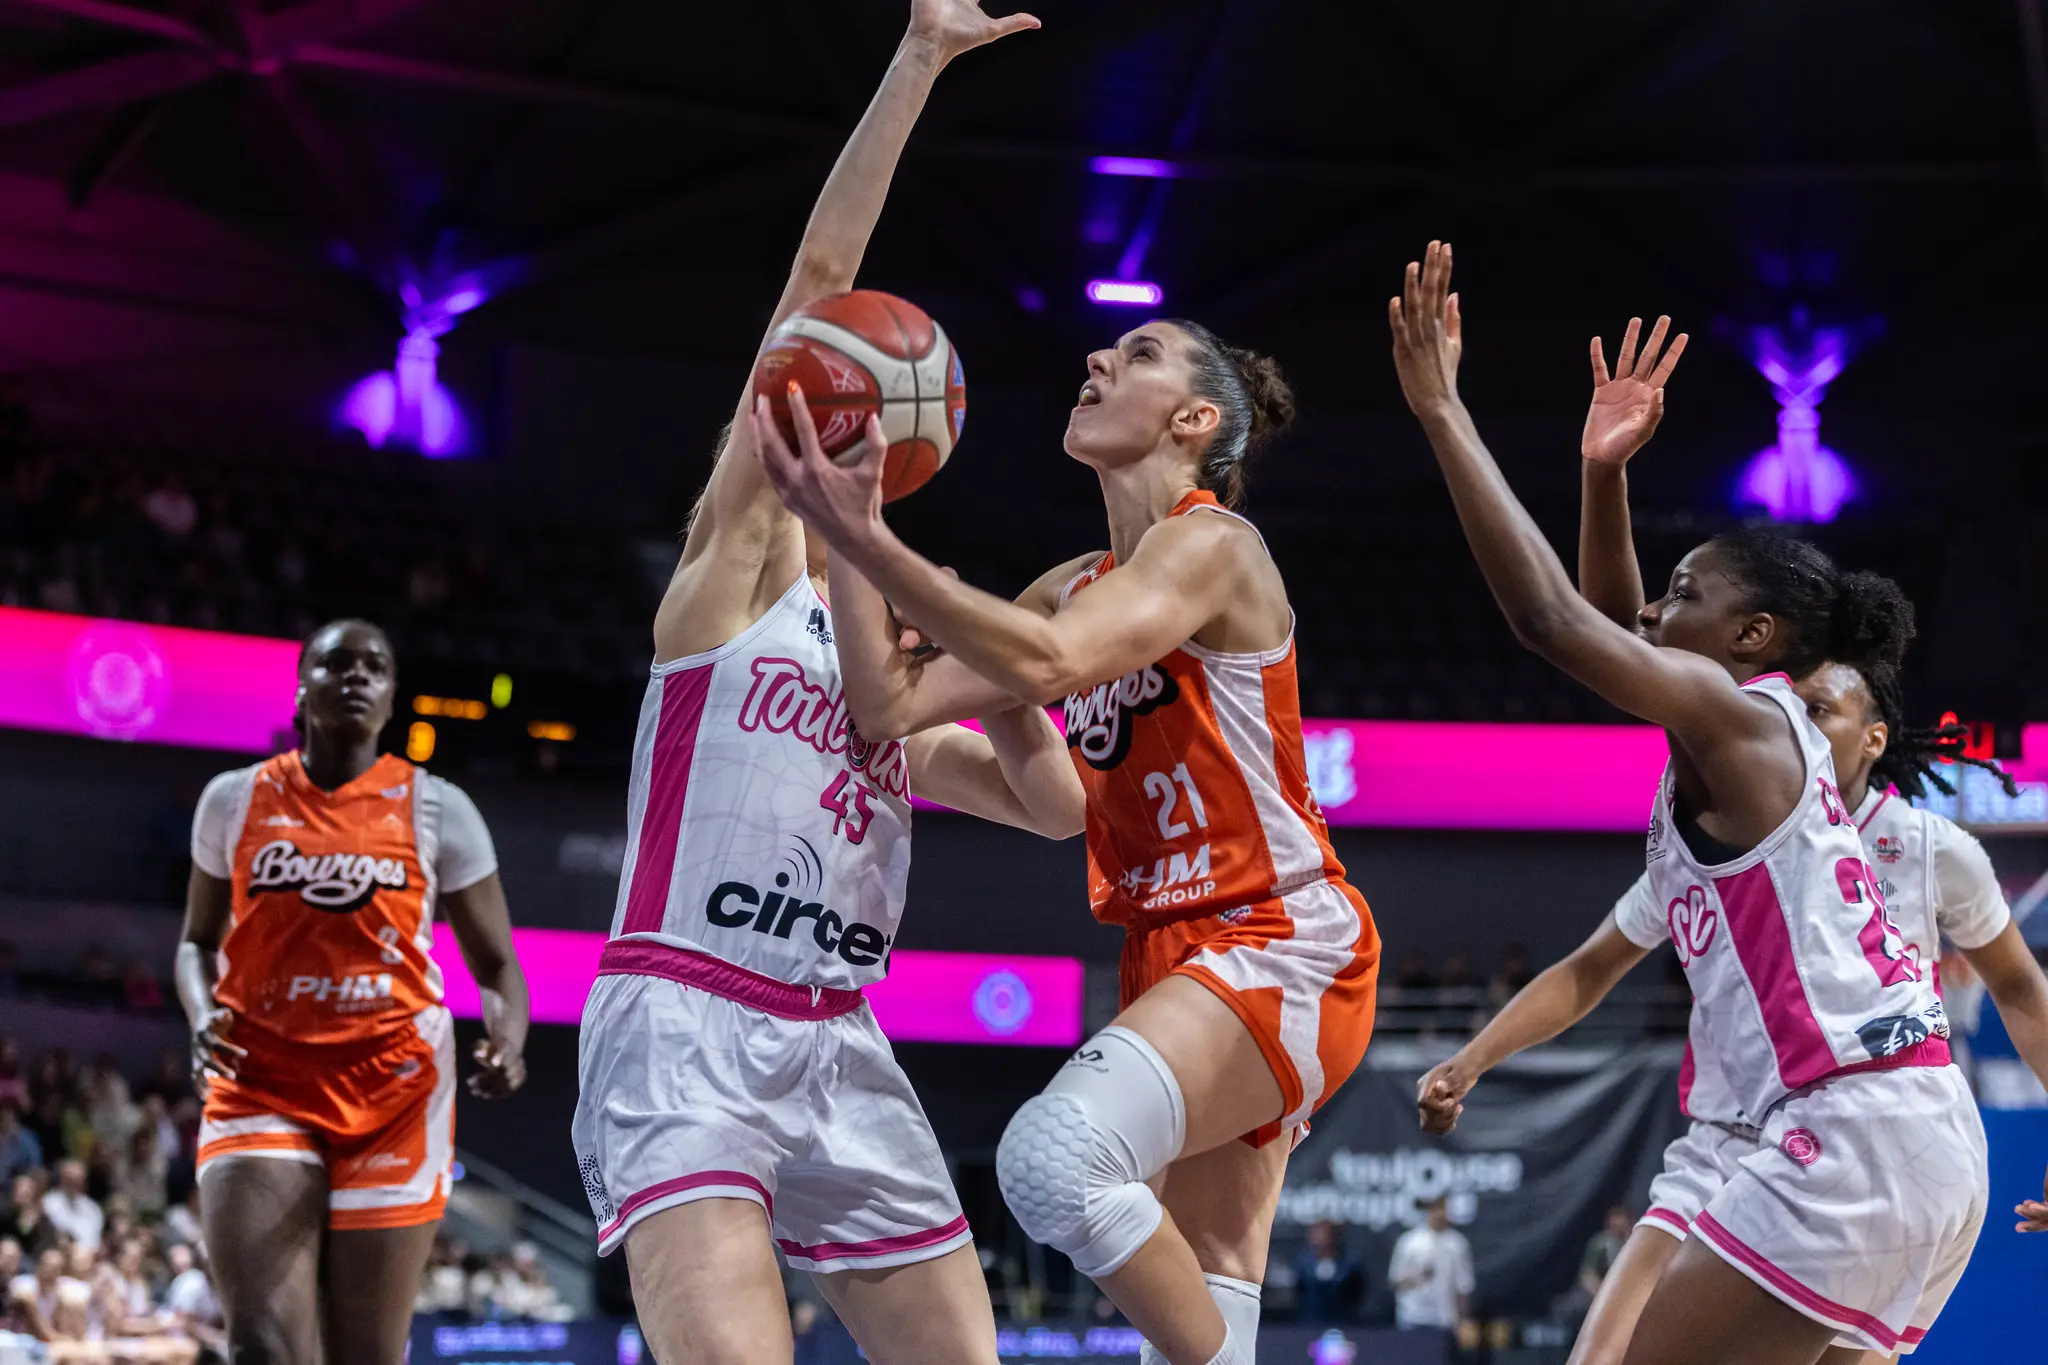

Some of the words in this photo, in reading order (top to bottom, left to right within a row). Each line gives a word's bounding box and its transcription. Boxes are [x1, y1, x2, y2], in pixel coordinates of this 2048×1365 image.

[820, 769, 878, 845] 45
[1143, 762, 1208, 841] 21
[251, 839, 406, 905] Bourges
[287, 973, 392, 1000] PHM
